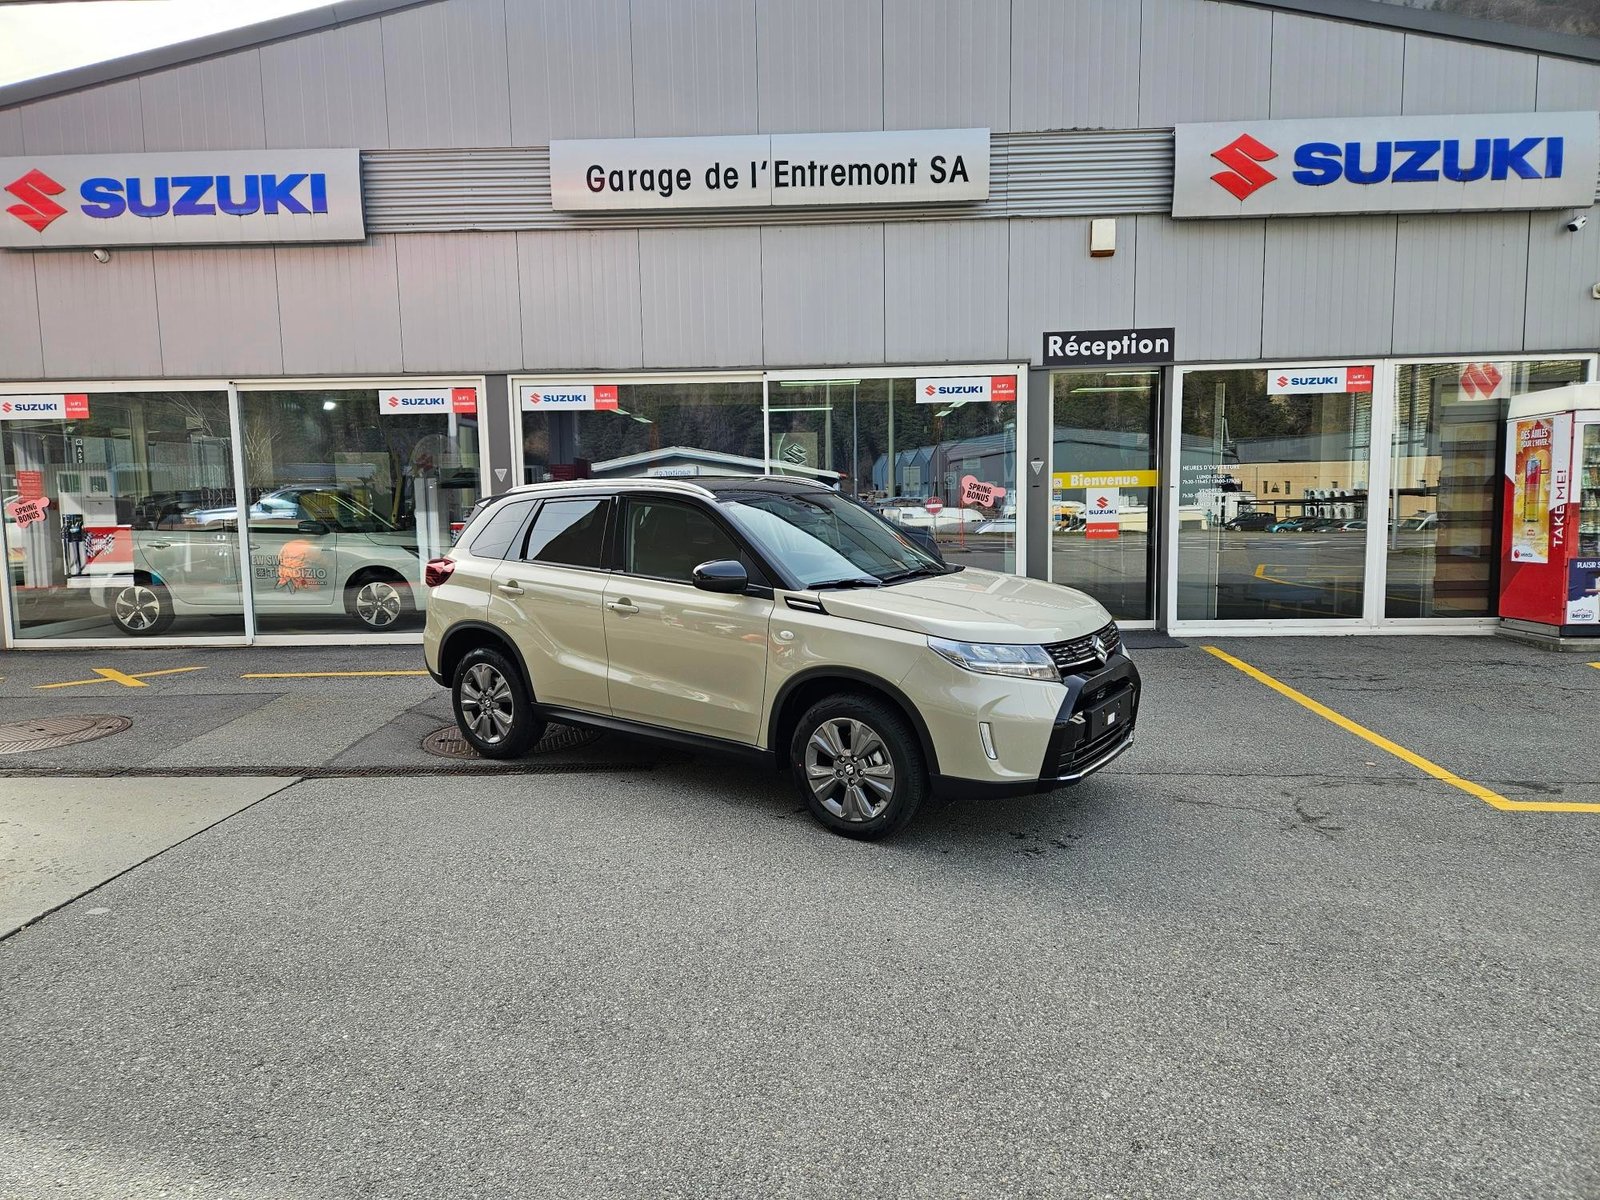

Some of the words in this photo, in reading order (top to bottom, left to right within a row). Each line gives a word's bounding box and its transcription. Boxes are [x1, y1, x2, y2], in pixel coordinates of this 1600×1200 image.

[1292, 136, 1564, 186] SUZUKI
[586, 163, 692, 198] Garage
[705, 161, 739, 191] de
[750, 156, 917, 190] l'Entremont
[930, 155, 970, 184] SA
[80, 173, 328, 219] SUZUKI
[1048, 333, 1169, 360] Réception
[1291, 377, 1338, 385] SUZUKI
[938, 385, 983, 394] SUZUKI
[401, 397, 445, 406] SUZUKI
[543, 394, 587, 402] SUZUKI
[14, 403, 57, 411] SUZUKI
[1070, 474, 1139, 487] Bienvenue
[1556, 469, 1567, 500] ME!
[968, 482, 992, 495] SPRING
[966, 490, 990, 503] BONUS
[14, 502, 38, 516] SPRING
[17, 510, 41, 524] BONUS
[1552, 504, 1565, 547] TAKE
[1576, 561, 1597, 569] PLAISIR
